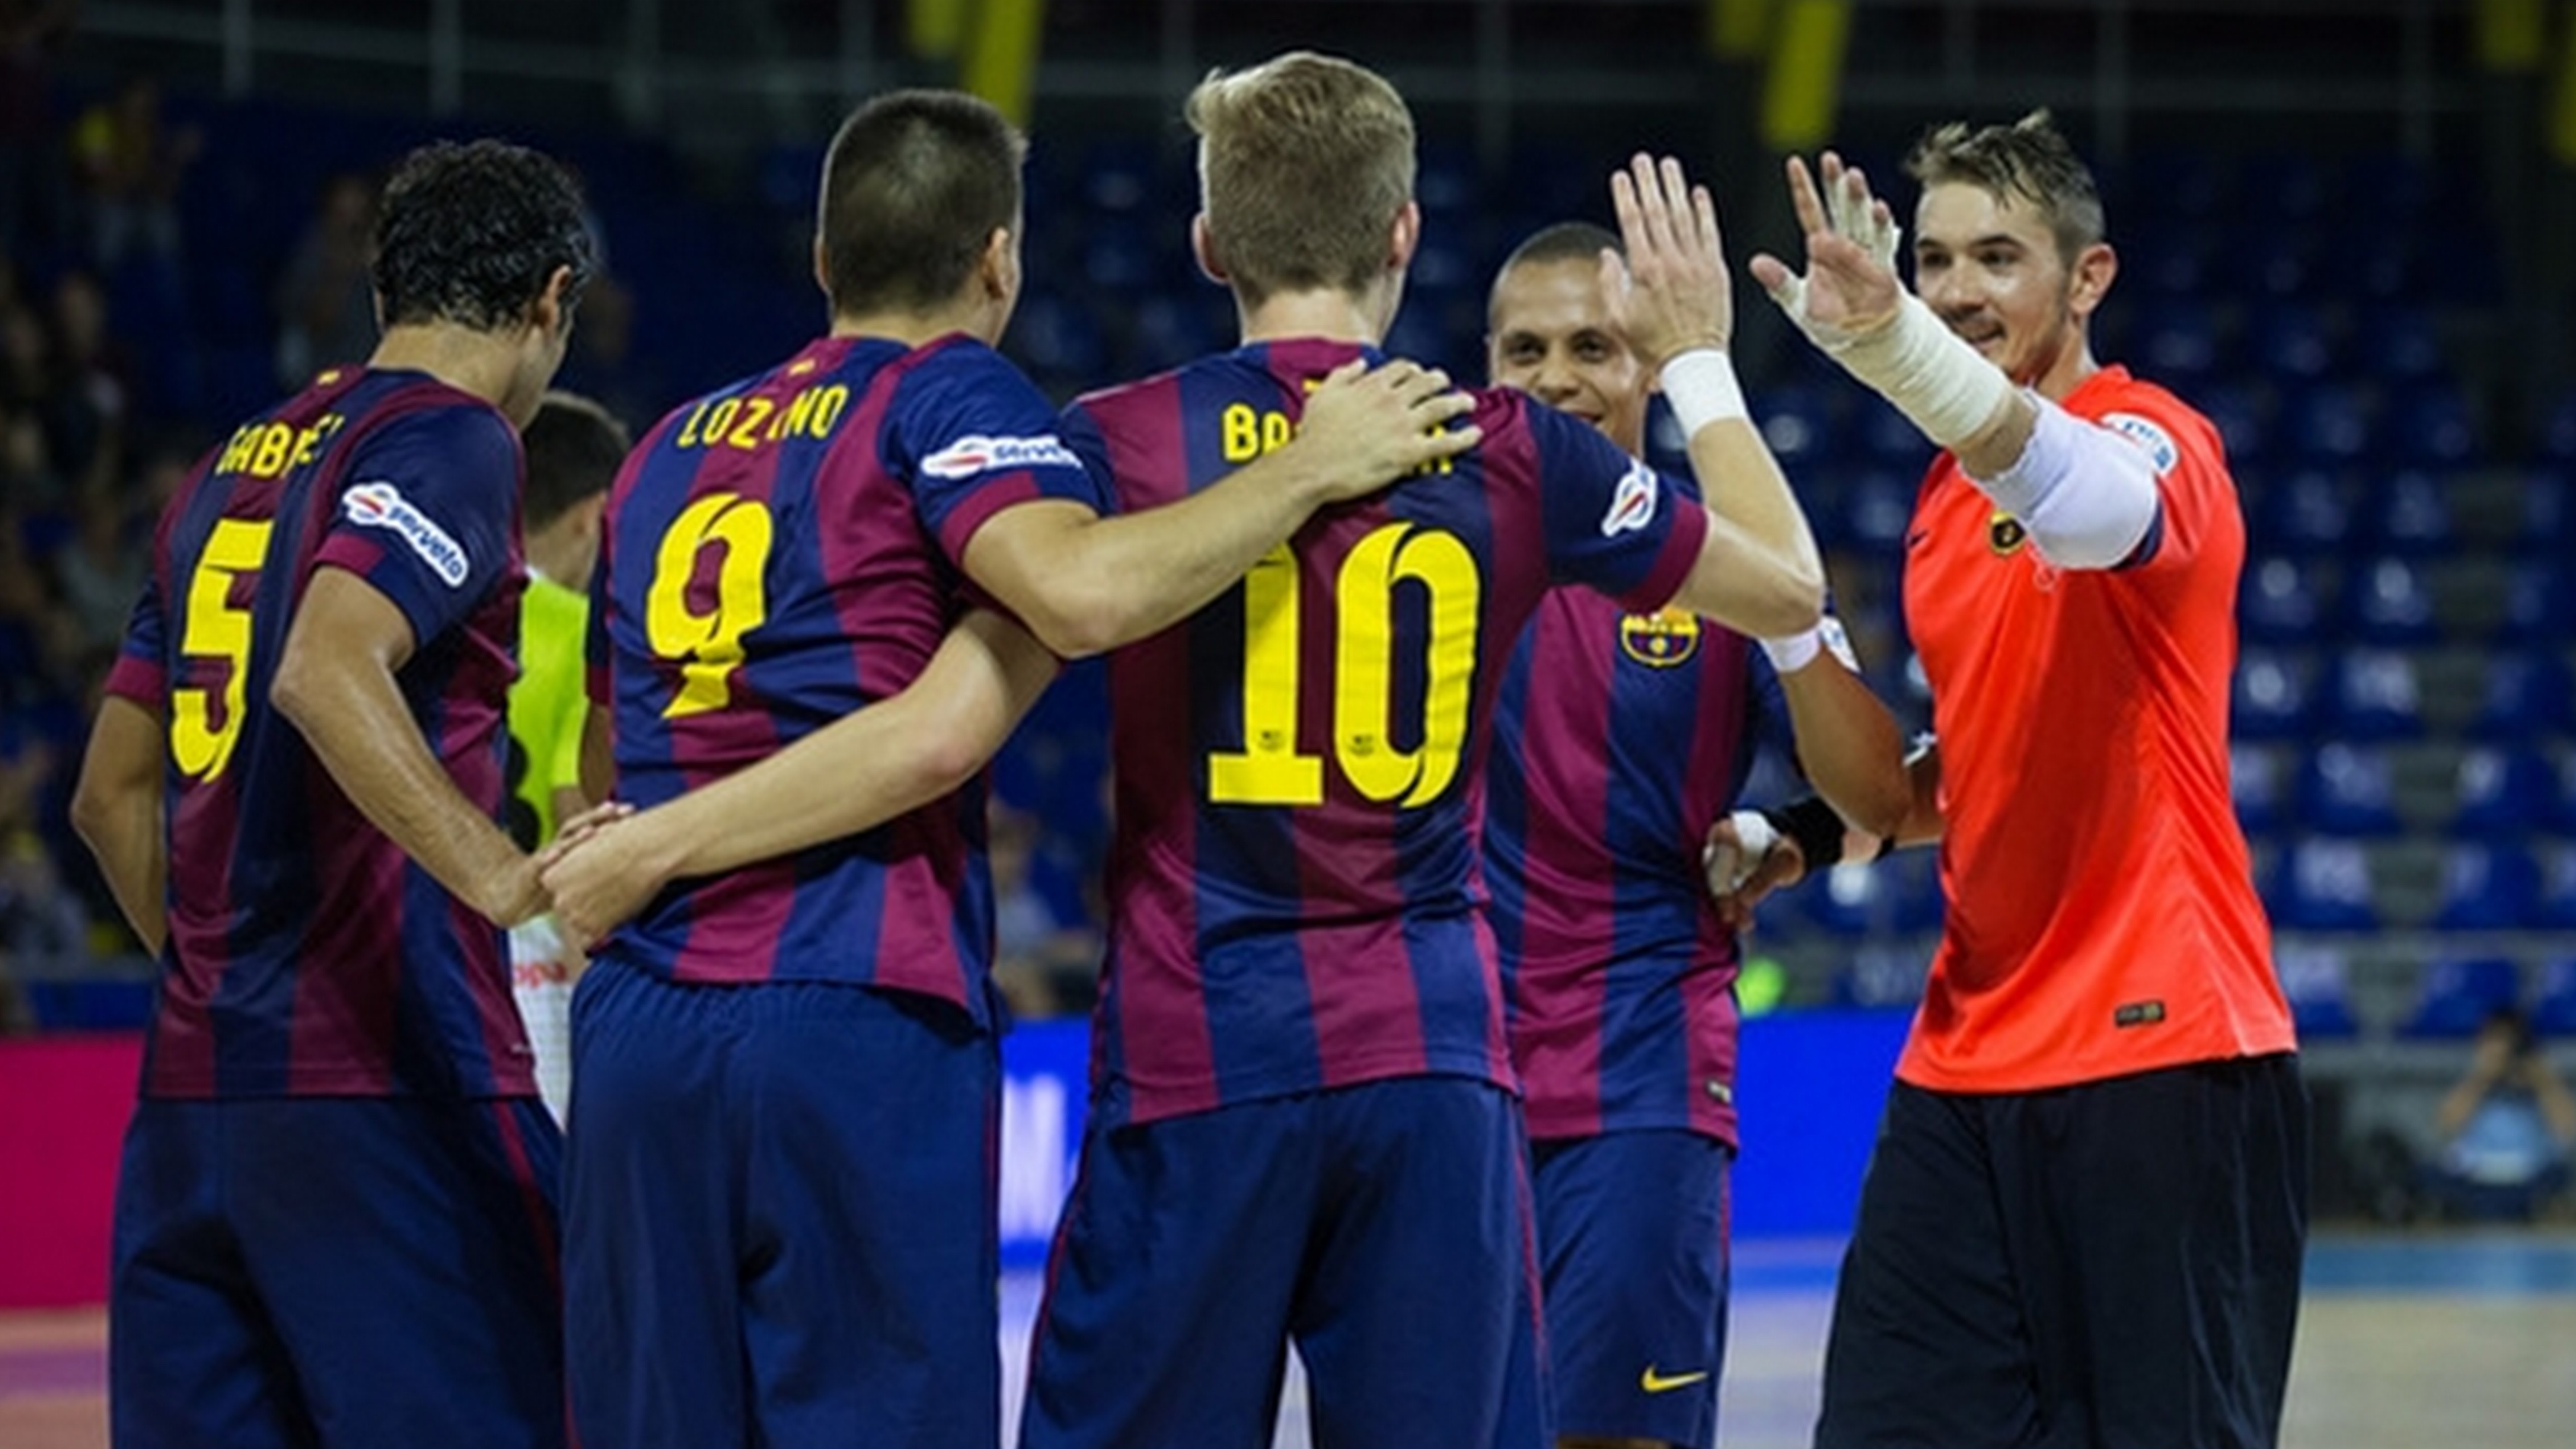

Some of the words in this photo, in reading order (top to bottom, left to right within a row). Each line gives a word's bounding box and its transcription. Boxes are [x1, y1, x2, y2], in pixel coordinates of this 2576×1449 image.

[171, 520, 274, 783] 5
[646, 493, 773, 719] 9
[1210, 521, 1479, 808] 10
